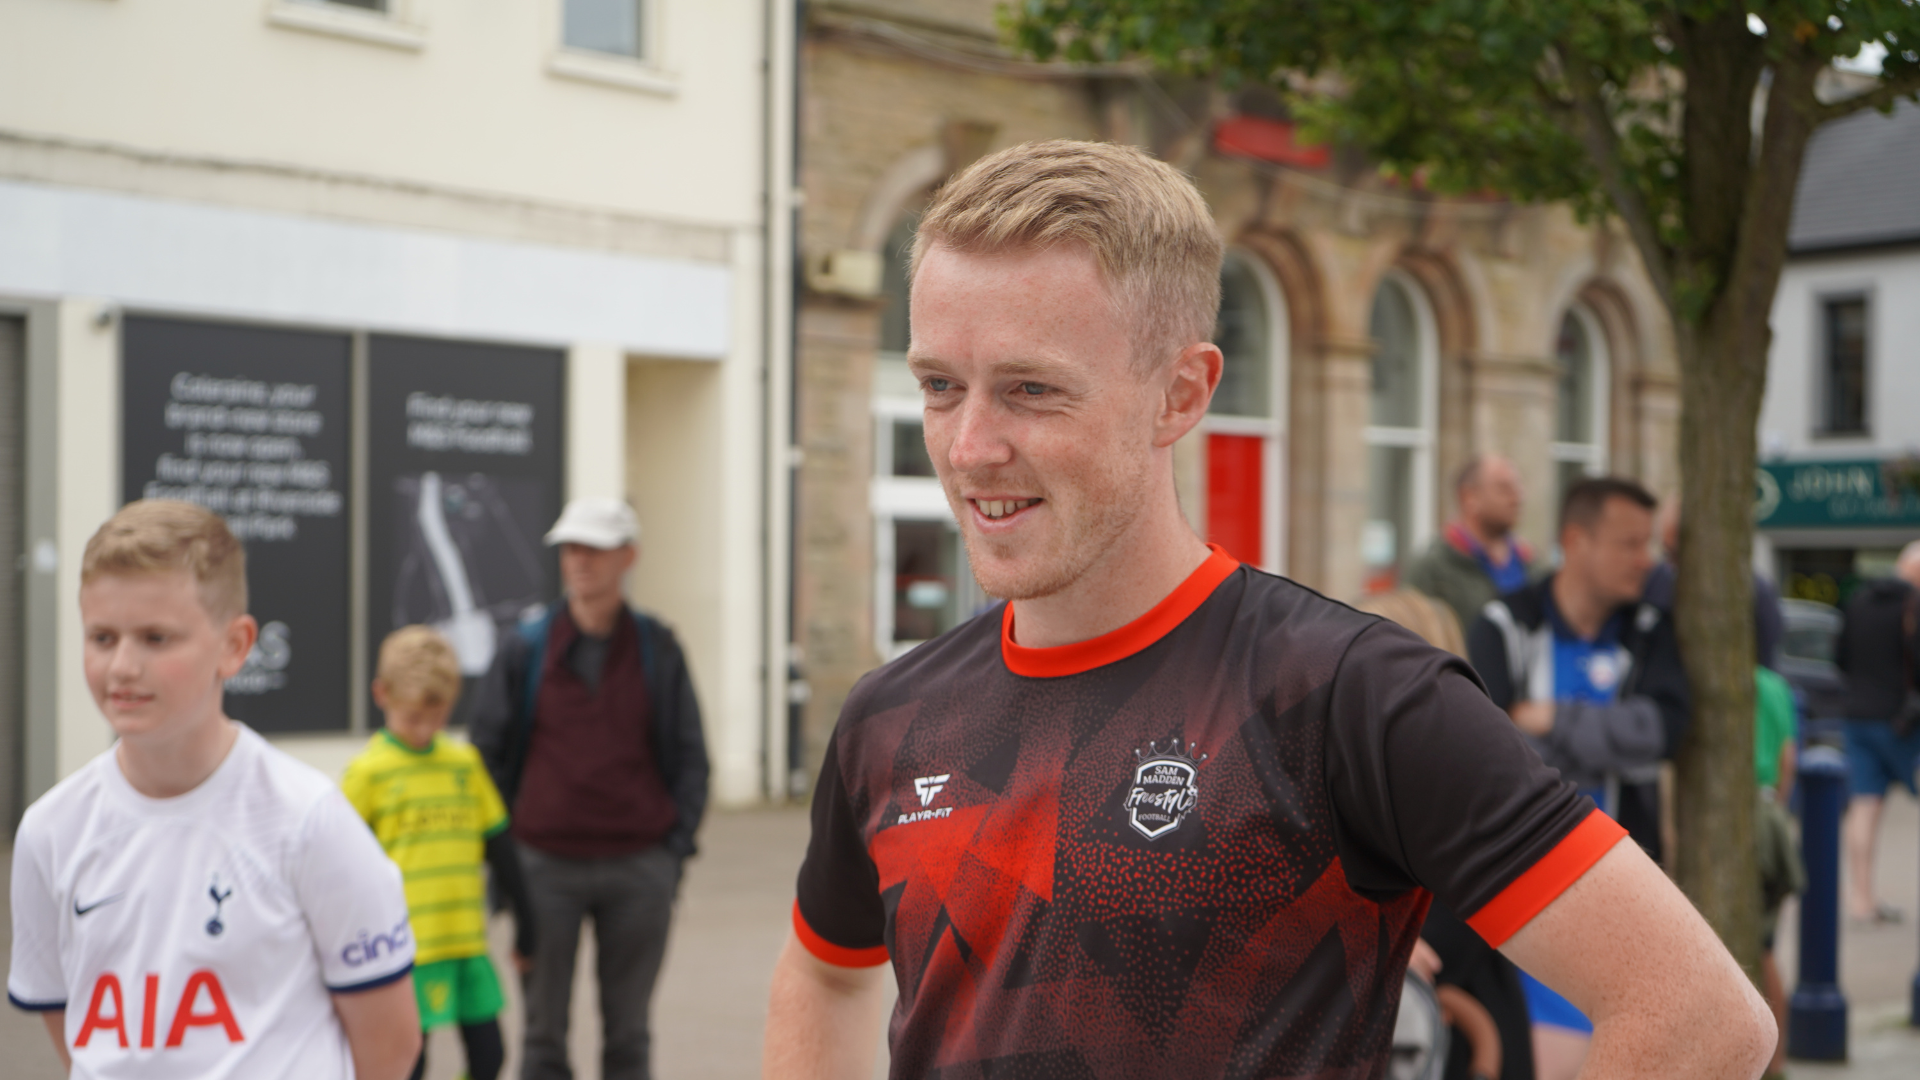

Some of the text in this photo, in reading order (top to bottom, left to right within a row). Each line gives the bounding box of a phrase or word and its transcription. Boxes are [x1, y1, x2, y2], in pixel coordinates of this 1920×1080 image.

[1152, 766, 1178, 775] SAM
[1143, 775, 1185, 785] MADDEN
[1128, 787, 1193, 814] Freestyle
[1138, 813, 1171, 822] FOOTBALL
[73, 969, 246, 1049] AIA
